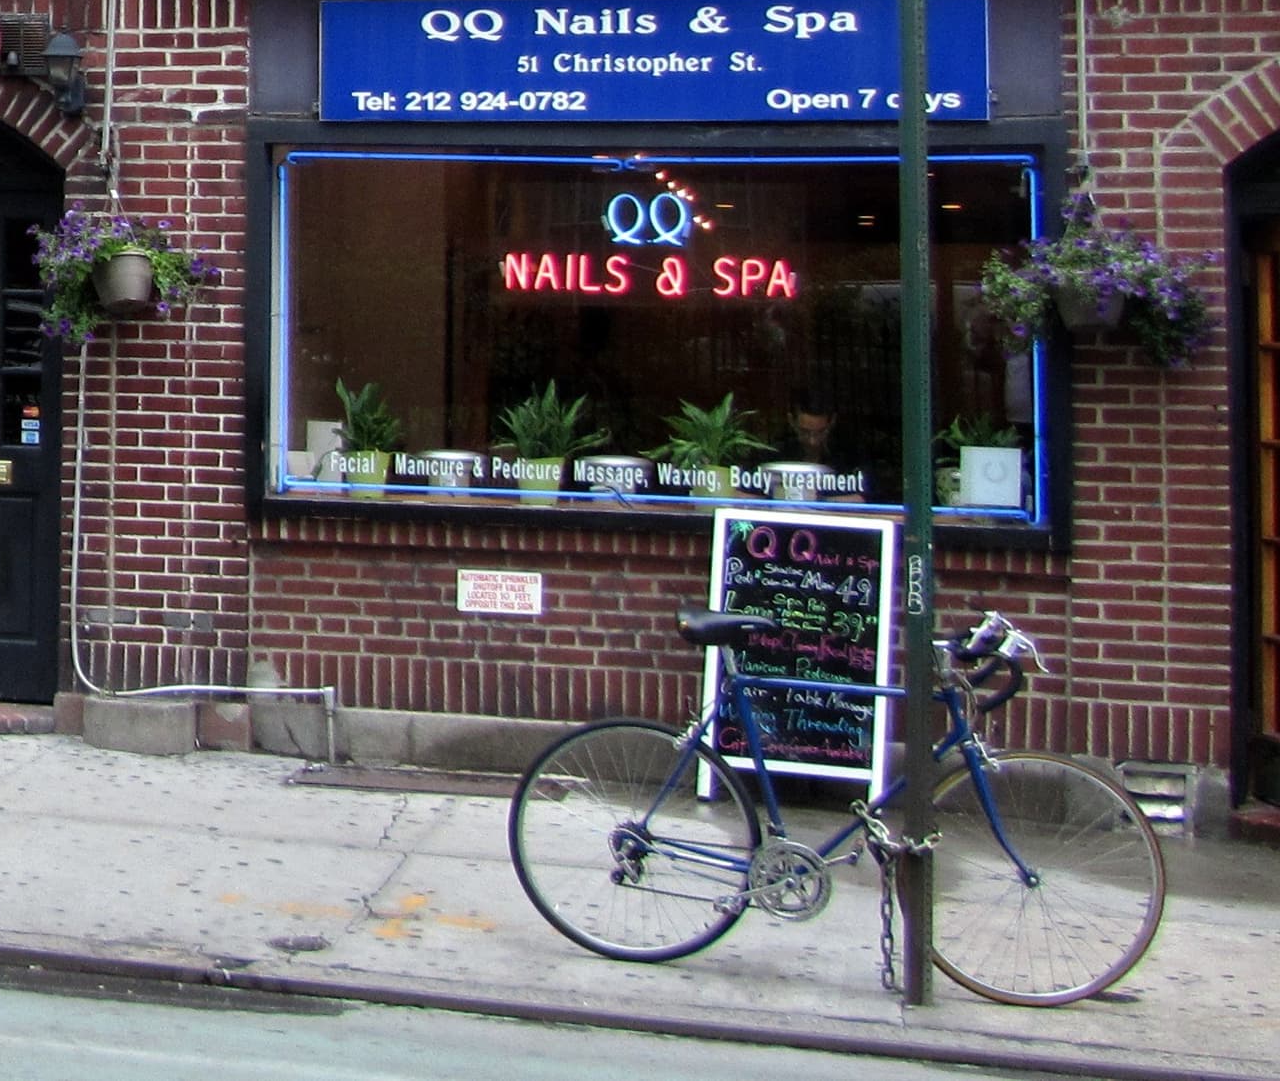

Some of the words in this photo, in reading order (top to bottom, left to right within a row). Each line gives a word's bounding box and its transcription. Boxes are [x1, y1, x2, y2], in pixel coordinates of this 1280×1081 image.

[420, 9, 504, 42] QQ
[534, 7, 658, 35] Nails
[689, 6, 730, 34] &
[763, 5, 859, 39] Spa
[516, 55, 540, 73] 51
[552, 52, 712, 77] Christopher
[729, 51, 764, 73] St.
[351, 91, 396, 112] Tel:
[404, 91, 452, 112] 212
[459, 90, 587, 112] 924-0782
[765, 88, 850, 114] Open
[857, 88, 876, 109] 7
[607, 192, 687, 246] QQ
[504, 253, 630, 294] NAILS
[655, 256, 687, 297] &
[712, 256, 793, 298] SPA
[395, 454, 464, 476] Manicure
[473, 456, 484, 478] &
[492, 456, 561, 481] Pedicure
[573, 460, 649, 488] Massage,
[656, 462, 721, 490] Waxing,
[730, 465, 772, 494] Body
[782, 470, 864, 493] treatment
[461, 573, 499, 582] AUTOMATIC
[500, 575, 538, 583] SPRINKLER
[835, 575, 872, 606] 49
[467, 591, 497, 599] LOCATED
[783, 707, 864, 749] Threading
